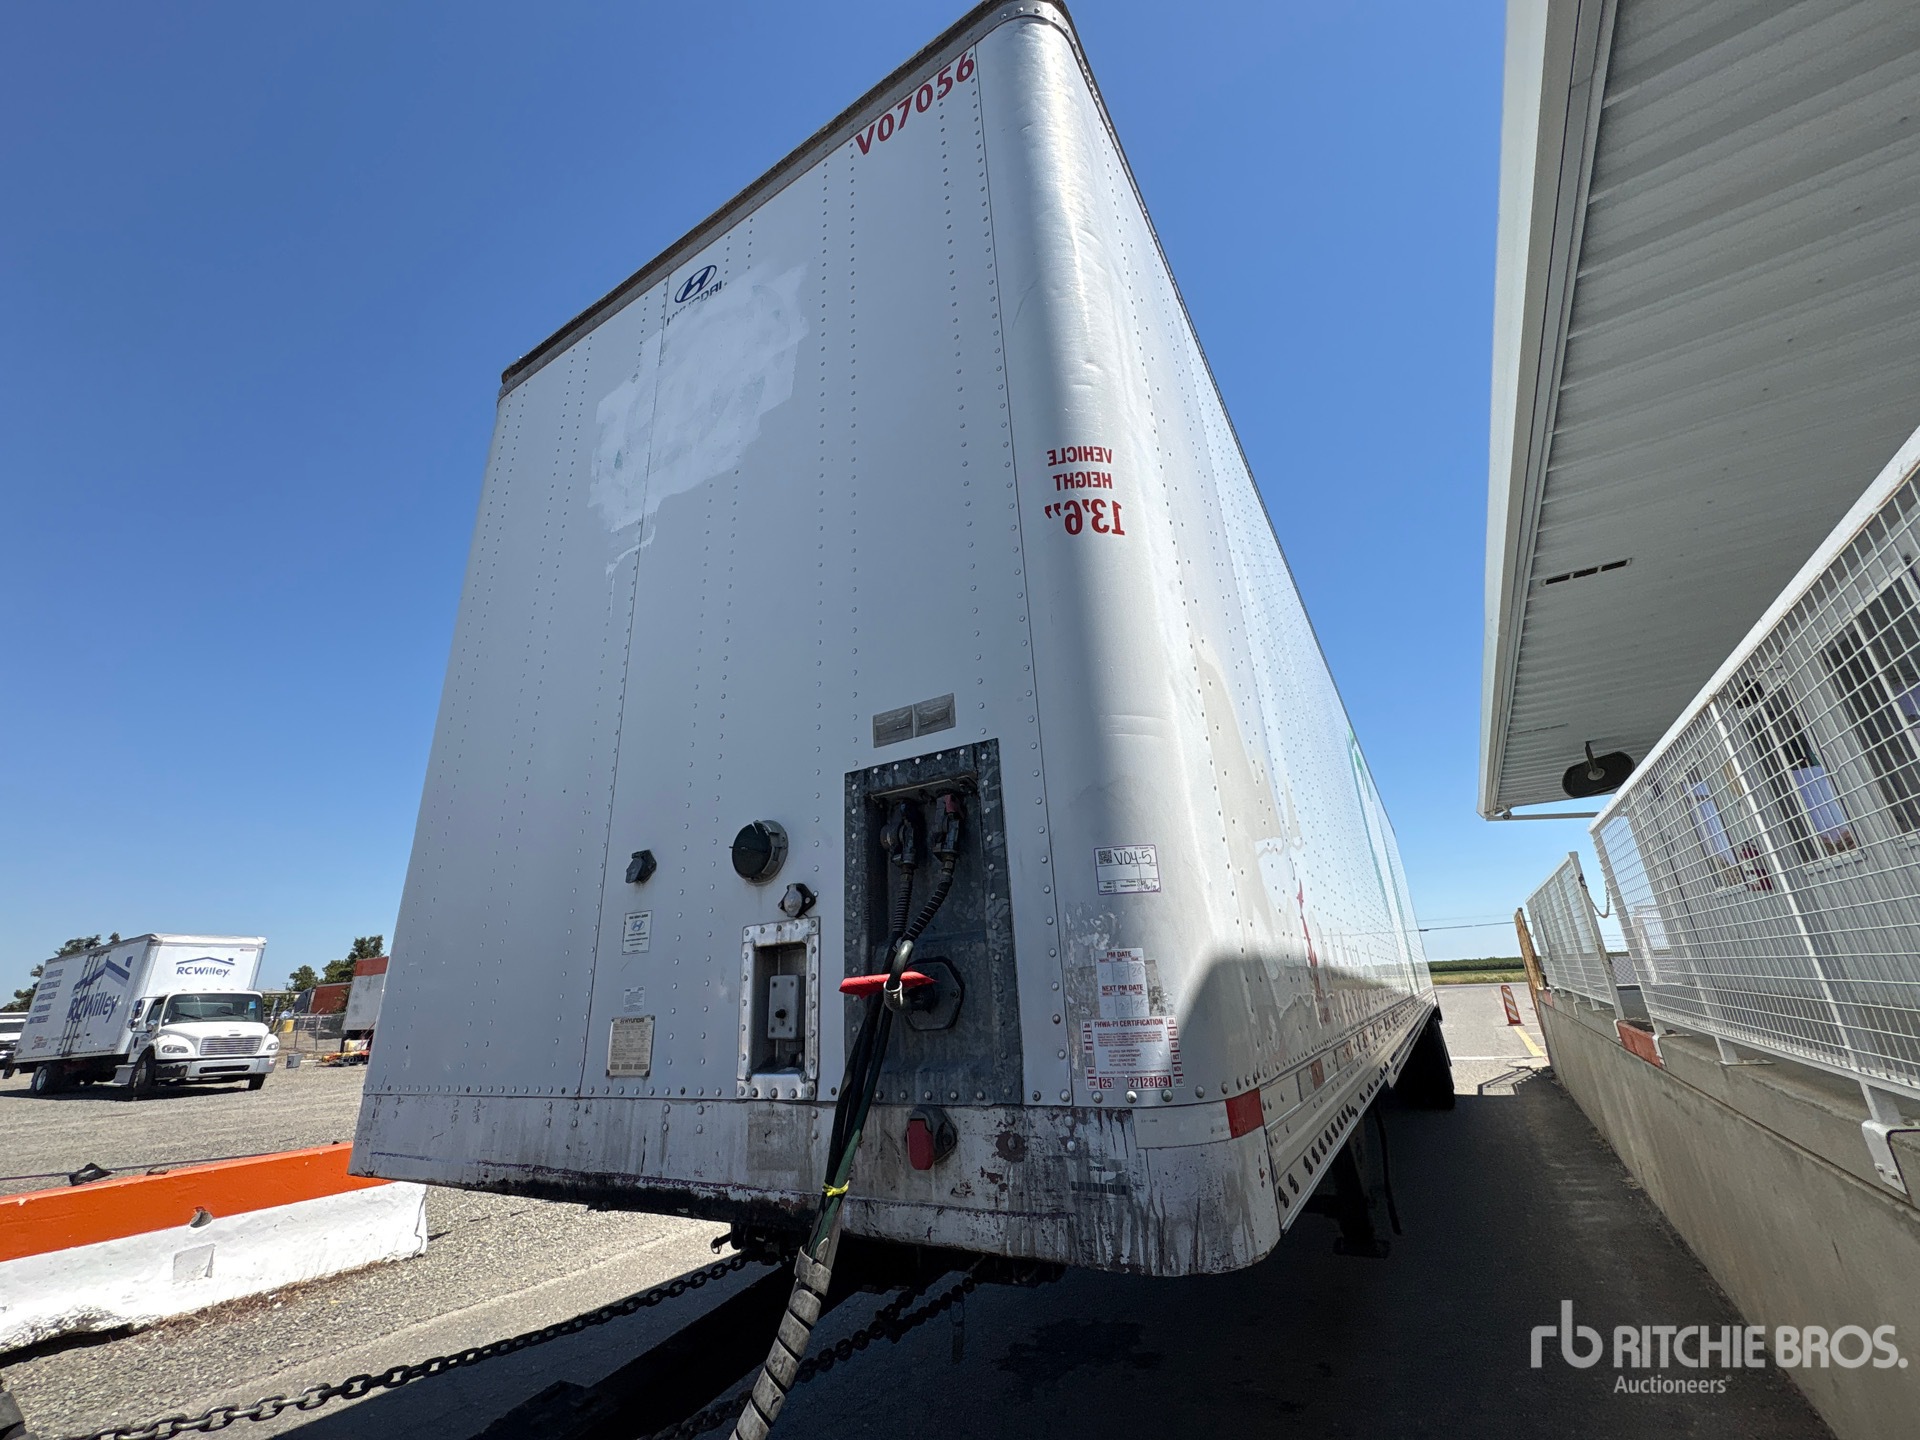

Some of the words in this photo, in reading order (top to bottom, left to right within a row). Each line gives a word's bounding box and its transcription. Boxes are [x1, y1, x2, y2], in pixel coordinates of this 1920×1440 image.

[855, 52, 975, 156] V07056
[1120, 1018, 1164, 1027] CERTIFICATION
[1102, 1078, 1112, 1088] 25
[1129, 1077, 1139, 1087] 27
[1143, 1077, 1154, 1087] 28
[1157, 1077, 1168, 1087] 29
